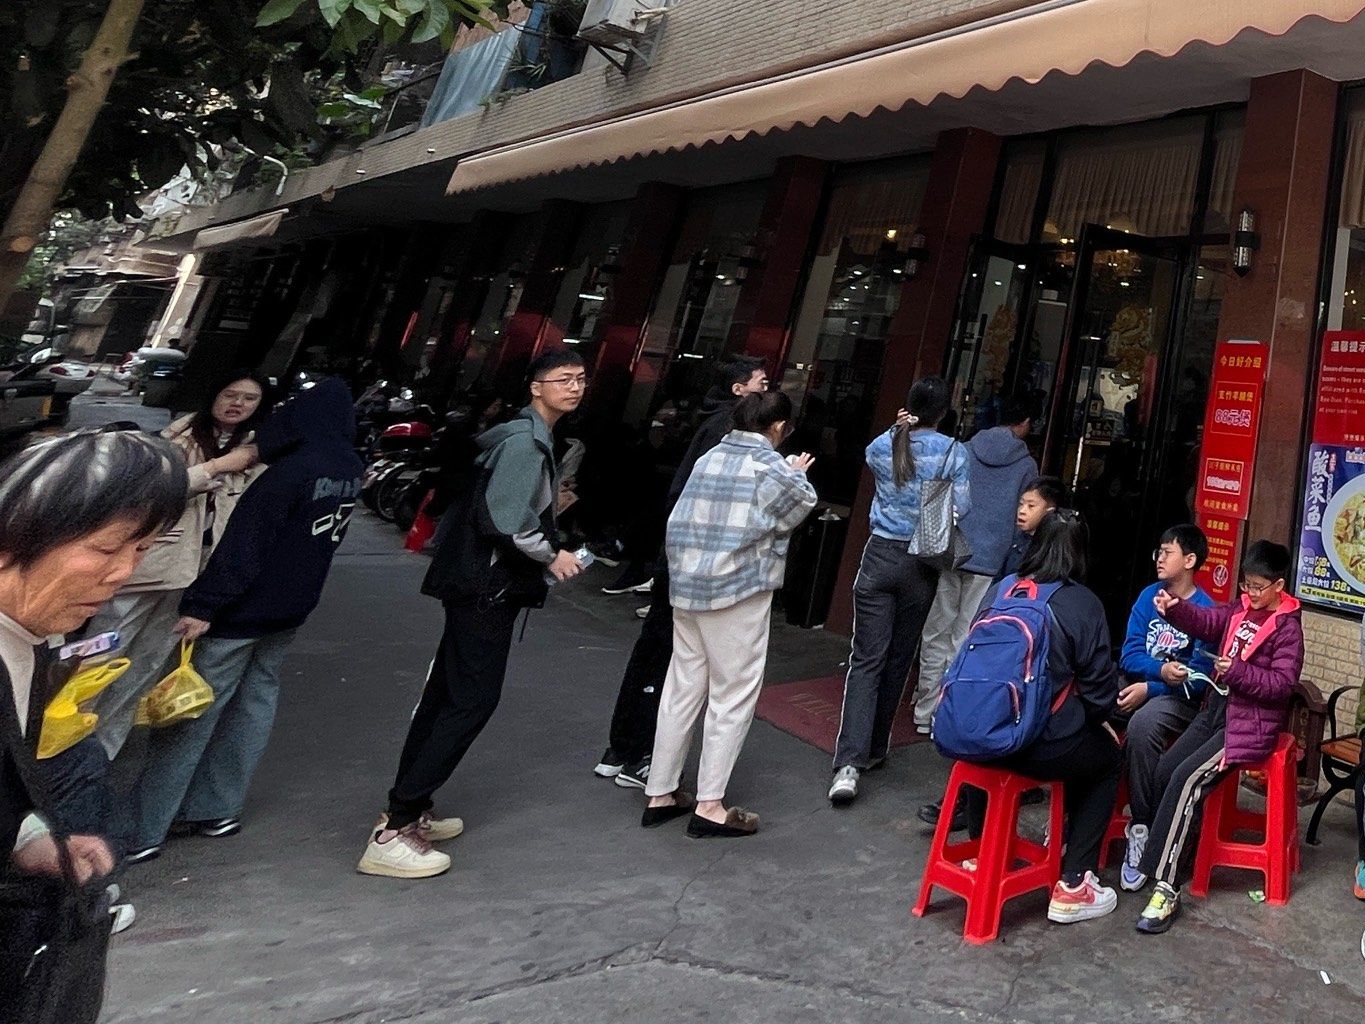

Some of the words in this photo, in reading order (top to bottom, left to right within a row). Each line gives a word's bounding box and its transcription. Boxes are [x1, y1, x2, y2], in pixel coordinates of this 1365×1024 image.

[1220, 355, 1262, 368] 今日好介绍
[1304, 449, 1330, 532] 酸菜鱼
